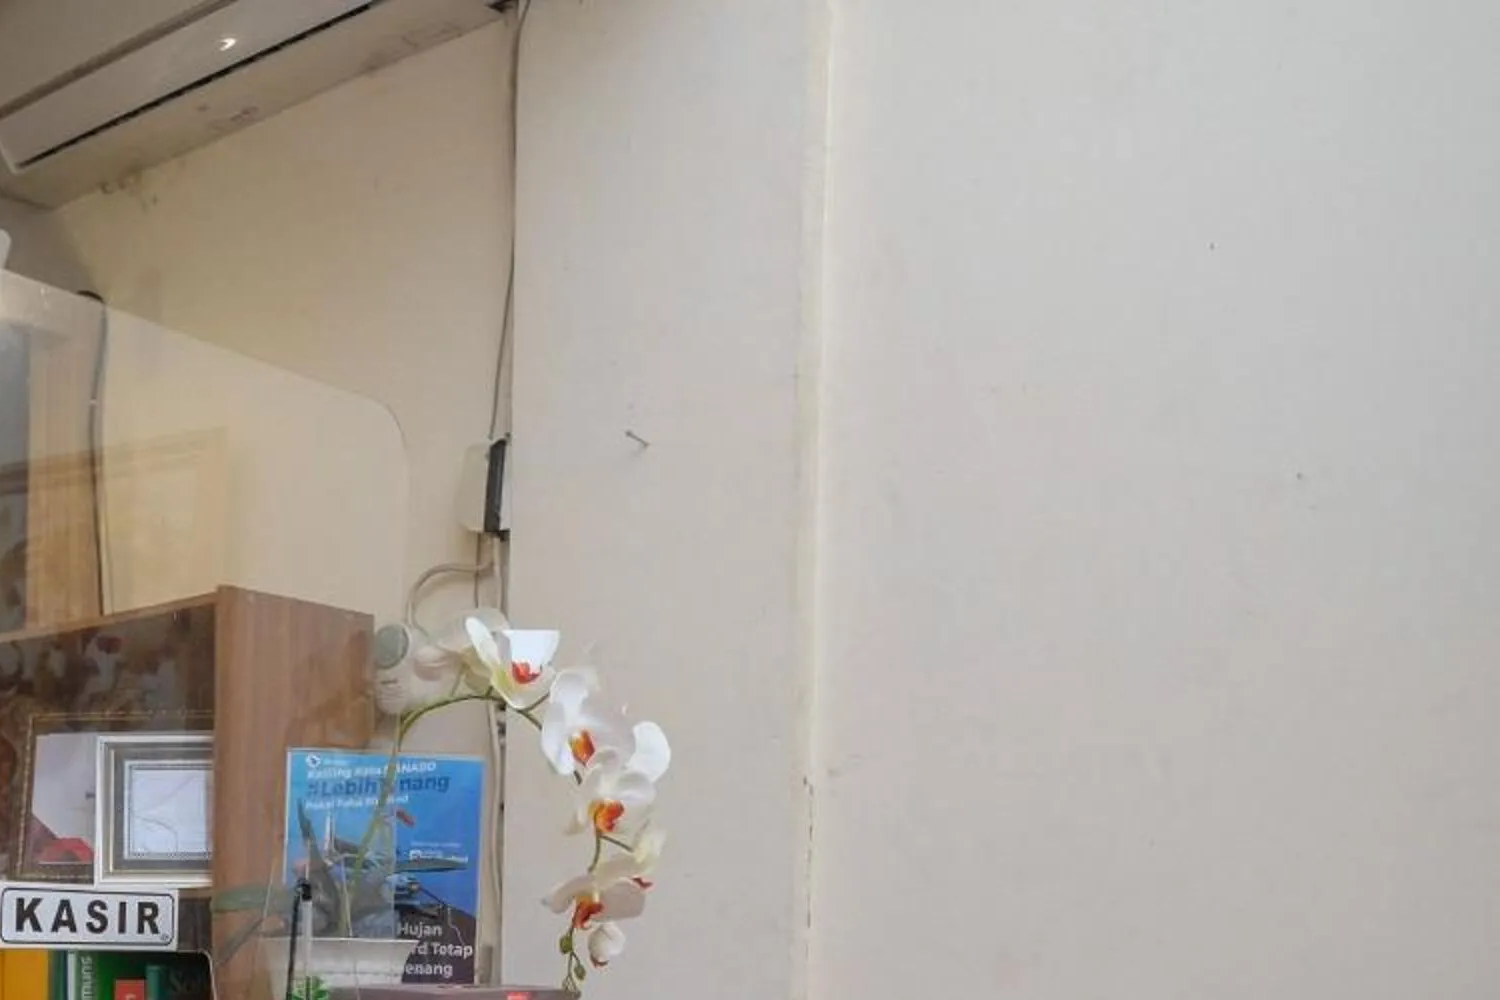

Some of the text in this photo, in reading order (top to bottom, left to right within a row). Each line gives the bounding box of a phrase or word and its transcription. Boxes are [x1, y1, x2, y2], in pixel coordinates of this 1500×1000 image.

[307, 775, 451, 798] #Lebihnang
[15, 897, 160, 935] KASIR
[396, 921, 442, 938] Hujan
[430, 942, 473, 960] Tetap
[405, 963, 453, 978] enang
